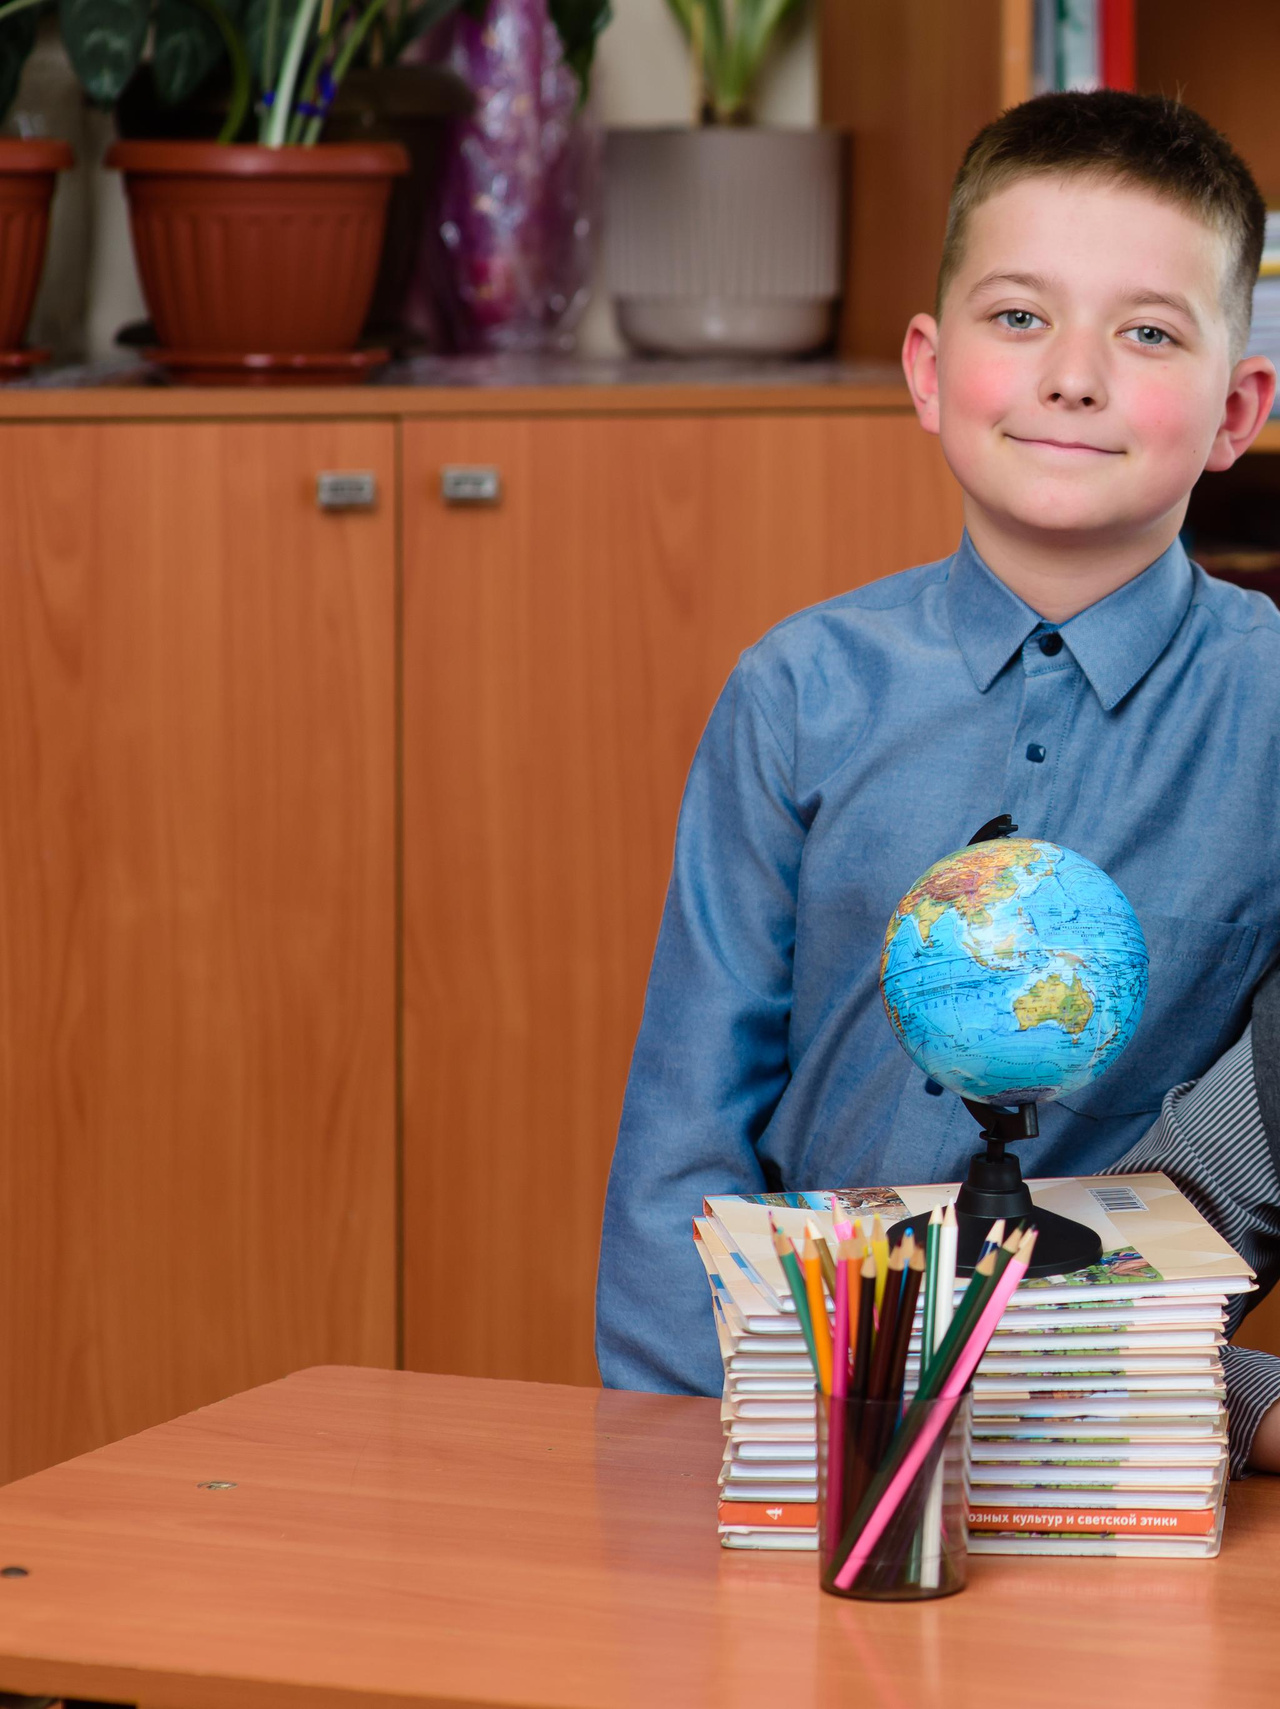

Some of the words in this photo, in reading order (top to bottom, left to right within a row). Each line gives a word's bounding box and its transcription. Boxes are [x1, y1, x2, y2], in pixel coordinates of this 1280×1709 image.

[766, 1507, 783, 1520] 4
[1012, 1514, 1063, 1527] культур
[1066, 1515, 1074, 1525] и
[1077, 1513, 1137, 1526] светской
[1140, 1516, 1178, 1527] этики
